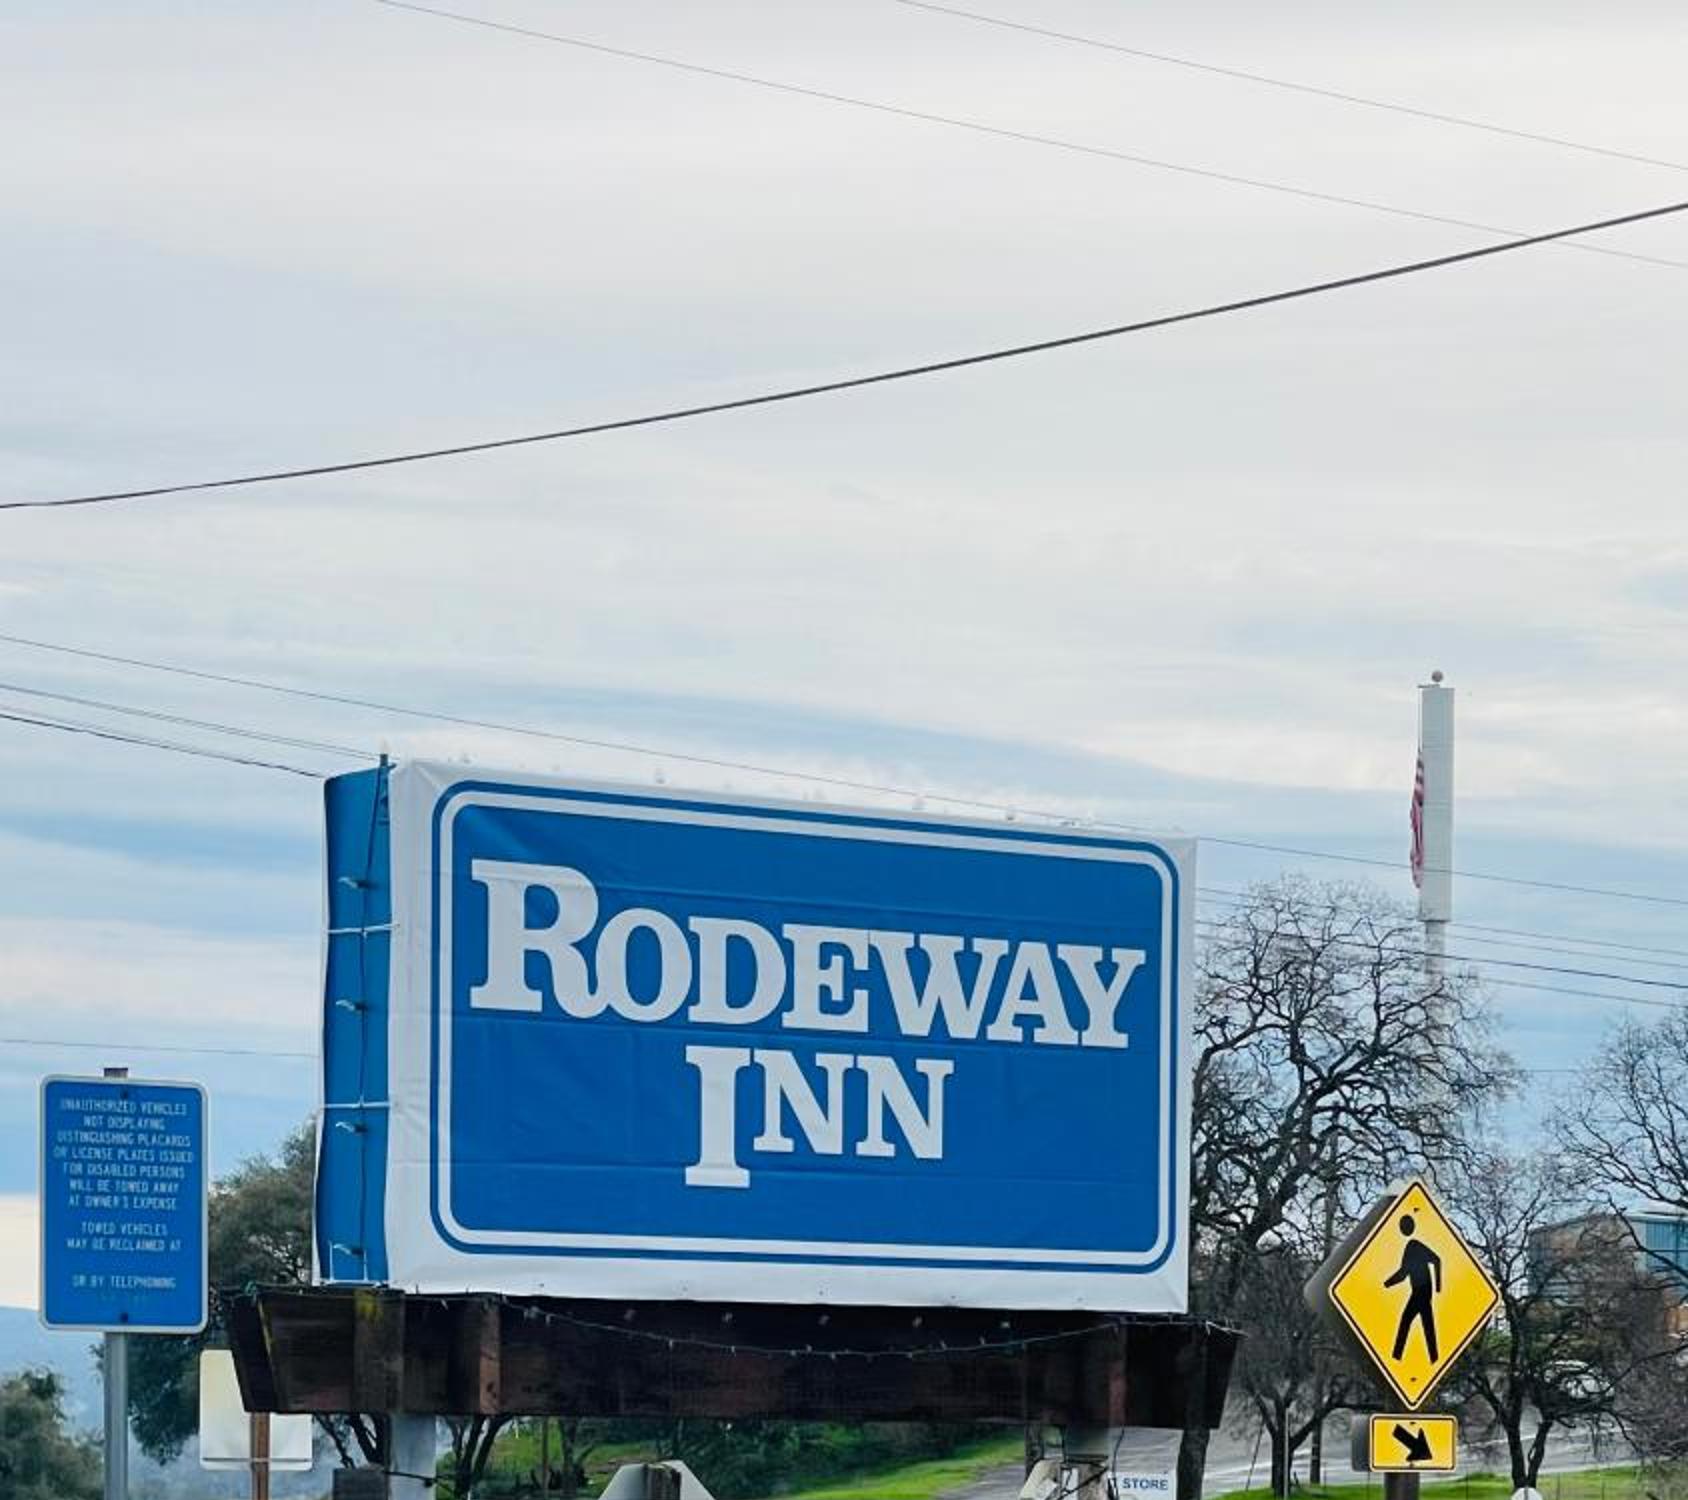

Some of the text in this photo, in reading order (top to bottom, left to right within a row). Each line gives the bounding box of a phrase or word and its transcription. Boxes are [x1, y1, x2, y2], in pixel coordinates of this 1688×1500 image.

[469, 859, 1147, 1048] RODEWAY
[61, 1098, 187, 1115] UNAUTHORIZED VEHICLES
[83, 1115, 165, 1130] NOT DISPLAYING
[685, 1044, 955, 1188] INN
[57, 1131, 191, 1147] DISTINGUISHING PLACARDS
[72, 1146, 112, 1159] LICENSE
[117, 1149, 154, 1162] PLATES
[159, 1151, 193, 1163] ISSUED
[63, 1161, 185, 1179] FOR DISABLED PERSONS
[69, 1179, 179, 1192] WILL BE TOWED AWAY
[69, 1194, 80, 1206] AT
[133, 1196, 176, 1210] EXPENSE
[81, 1221, 168, 1236] TOWED VEHICLES
[67, 1238, 182, 1251] MAY BE RECLAIMED AT
[1122, 1477, 1169, 1491] STORE
